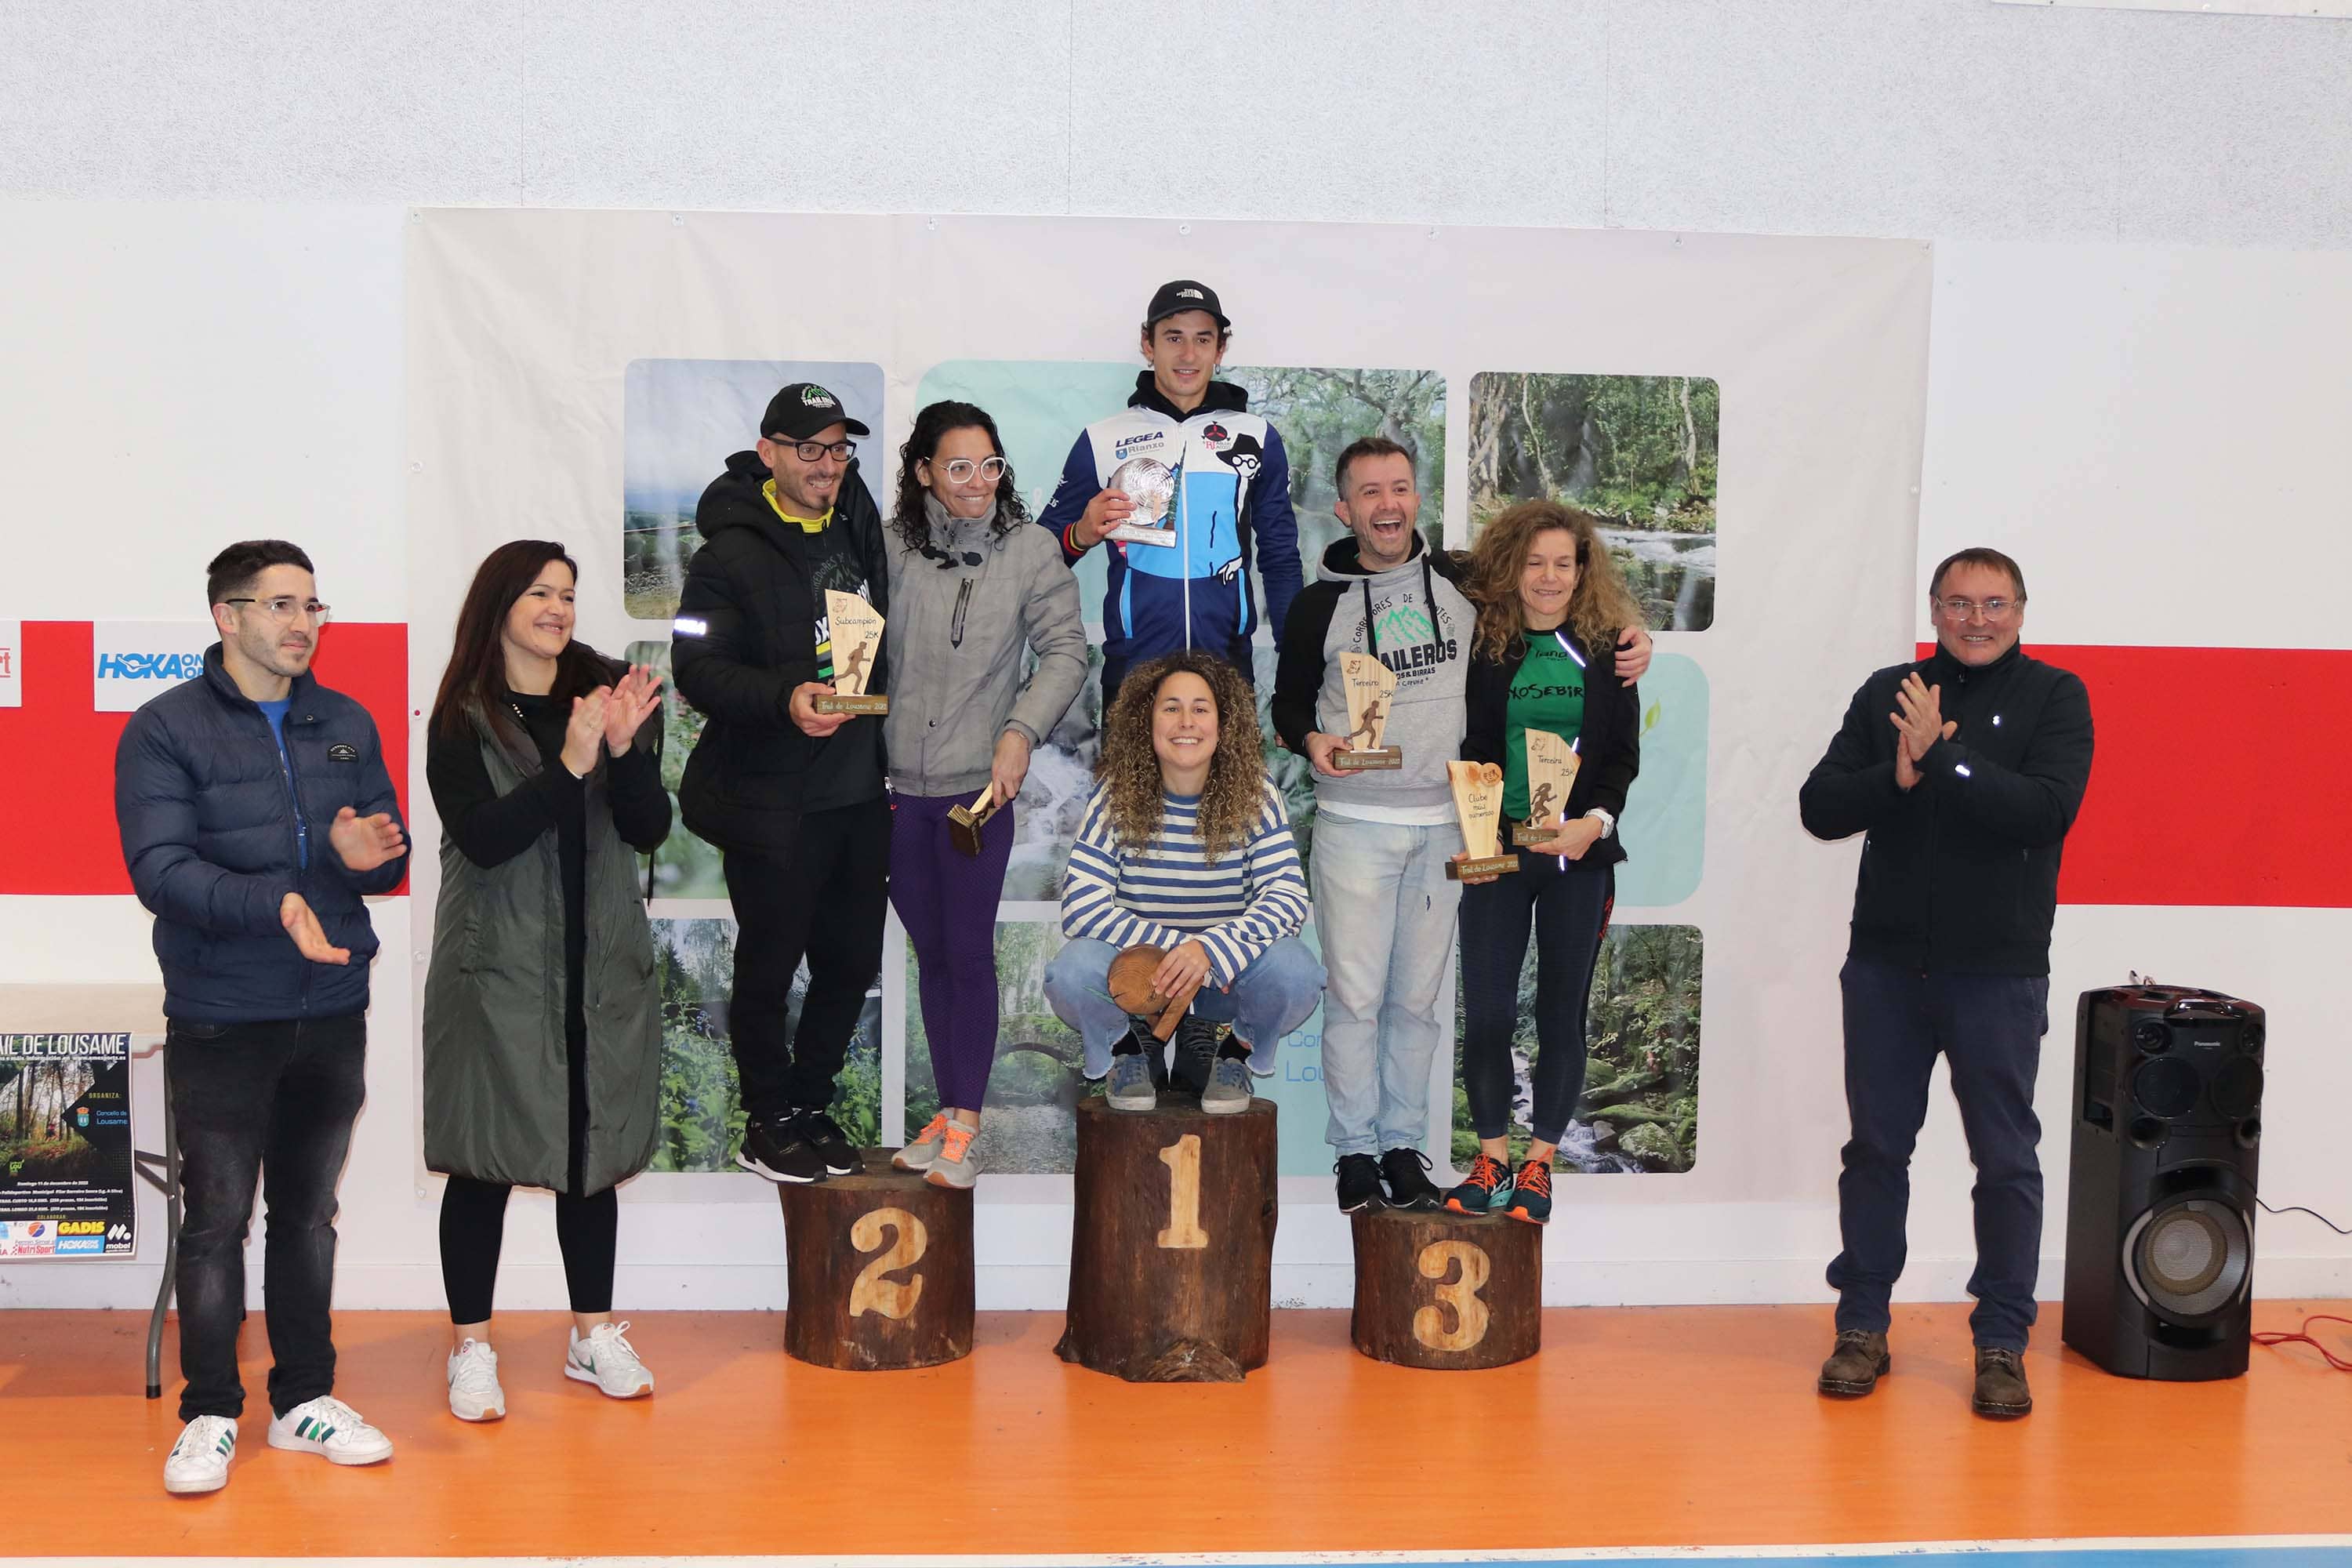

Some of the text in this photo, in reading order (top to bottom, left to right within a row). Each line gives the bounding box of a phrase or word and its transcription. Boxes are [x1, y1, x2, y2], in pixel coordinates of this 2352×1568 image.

[1116, 431, 1163, 448] LEGEA
[1128, 442, 1164, 453] Rianxo
[1403, 593, 1413, 603] DE
[866, 630, 879, 639] 25K
[1381, 639, 1457, 672] AILEROS
[98, 653, 183, 679] HOKA
[1380, 690, 1393, 699] 25K
[1562, 768, 1574, 777] 25K
[1468, 793, 1487, 804] Clube
[23, 1035, 44, 1055] DE
[48, 1034, 126, 1054] LOUSAME
[1158, 1134, 1208, 1248] 1
[58, 1221, 105, 1236] GADIS
[850, 1207, 927, 1318] 2
[1413, 1240, 1490, 1351] 3
